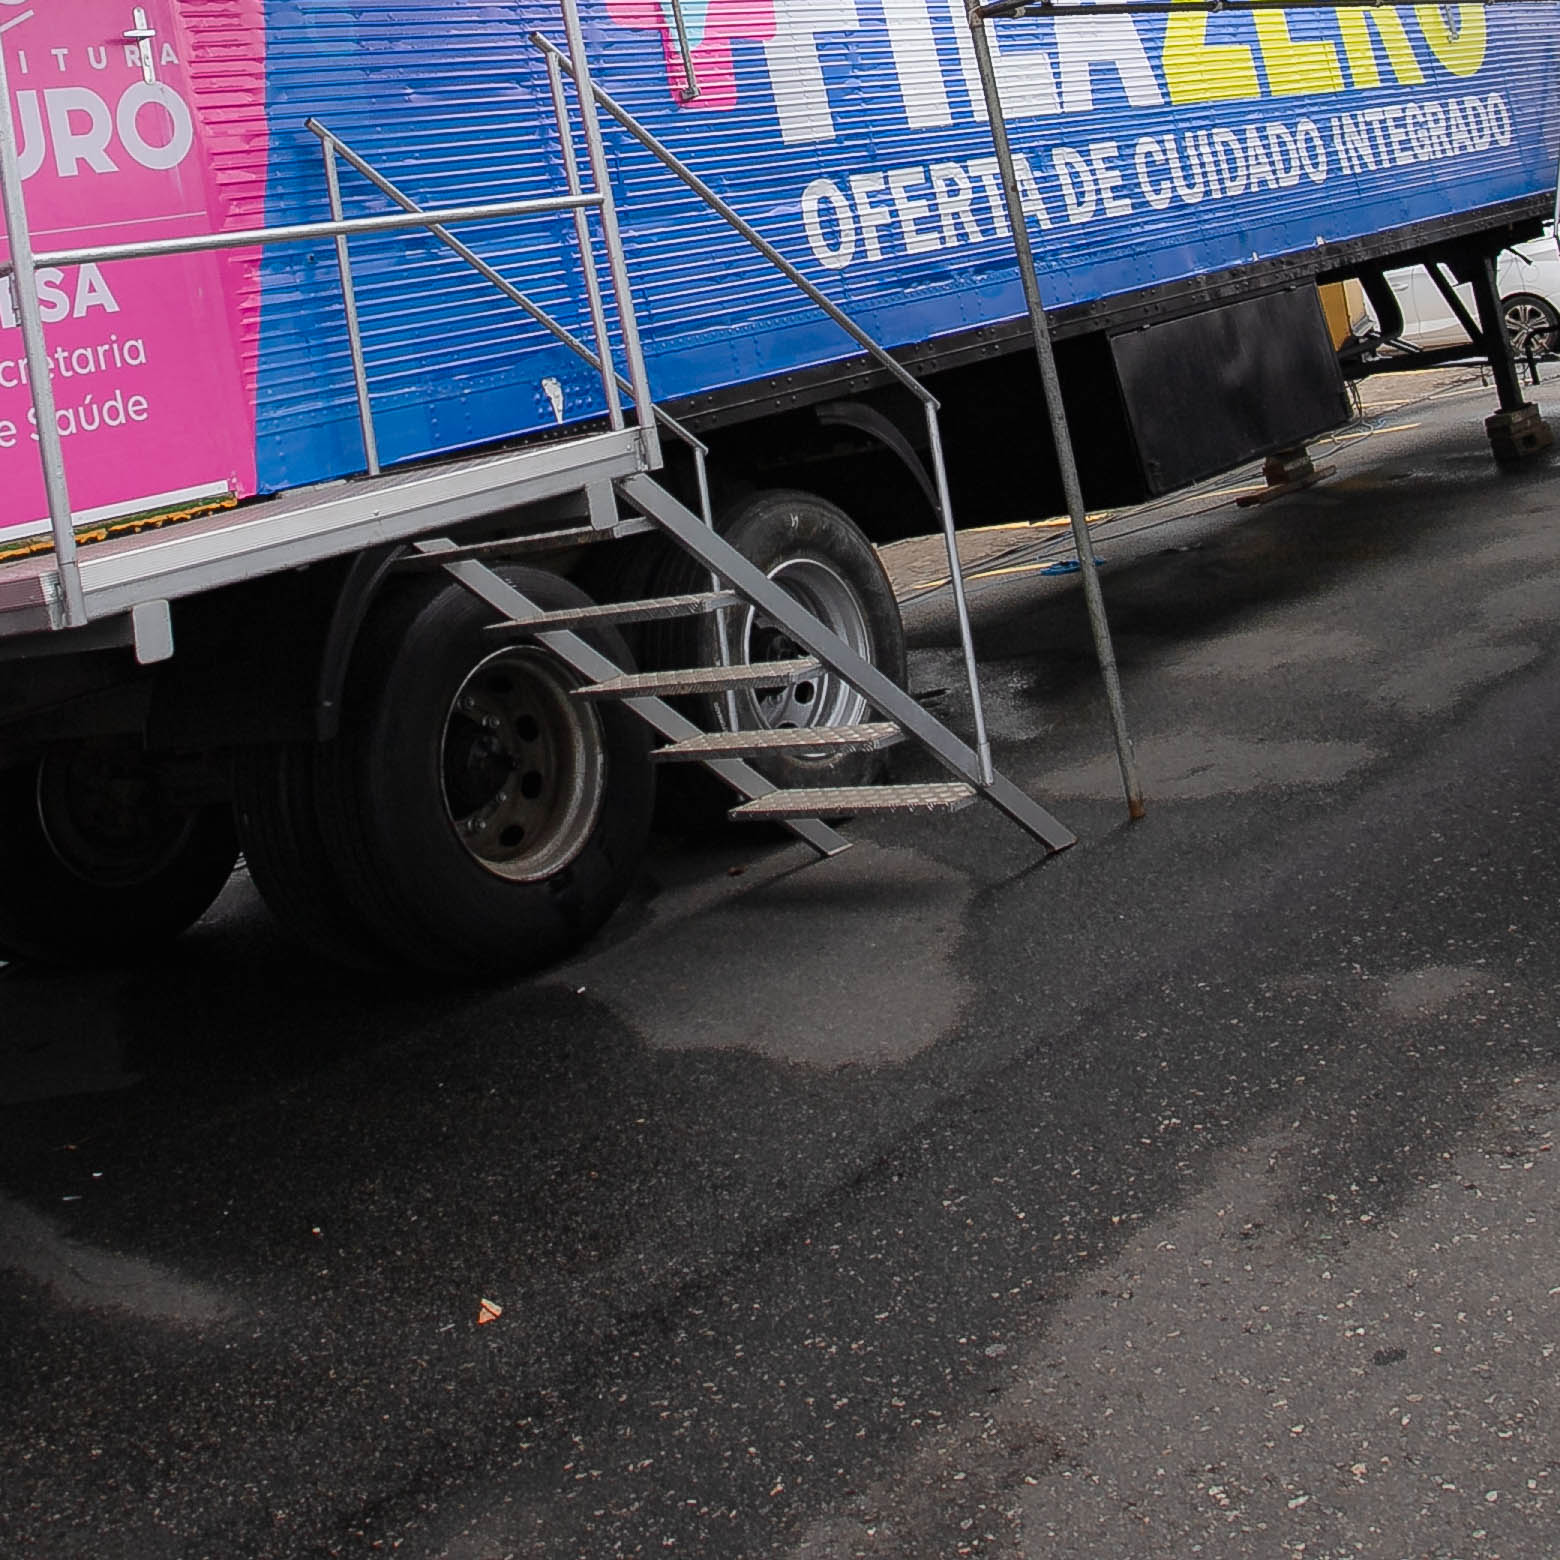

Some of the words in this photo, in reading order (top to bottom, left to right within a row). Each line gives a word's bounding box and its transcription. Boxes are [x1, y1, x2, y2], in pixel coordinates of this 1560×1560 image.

[801, 153, 1048, 270] OFERTA
[1060, 139, 1132, 224] DE
[1134, 113, 1327, 208] CUIDADO
[1338, 91, 1512, 176] INTEGRADO
